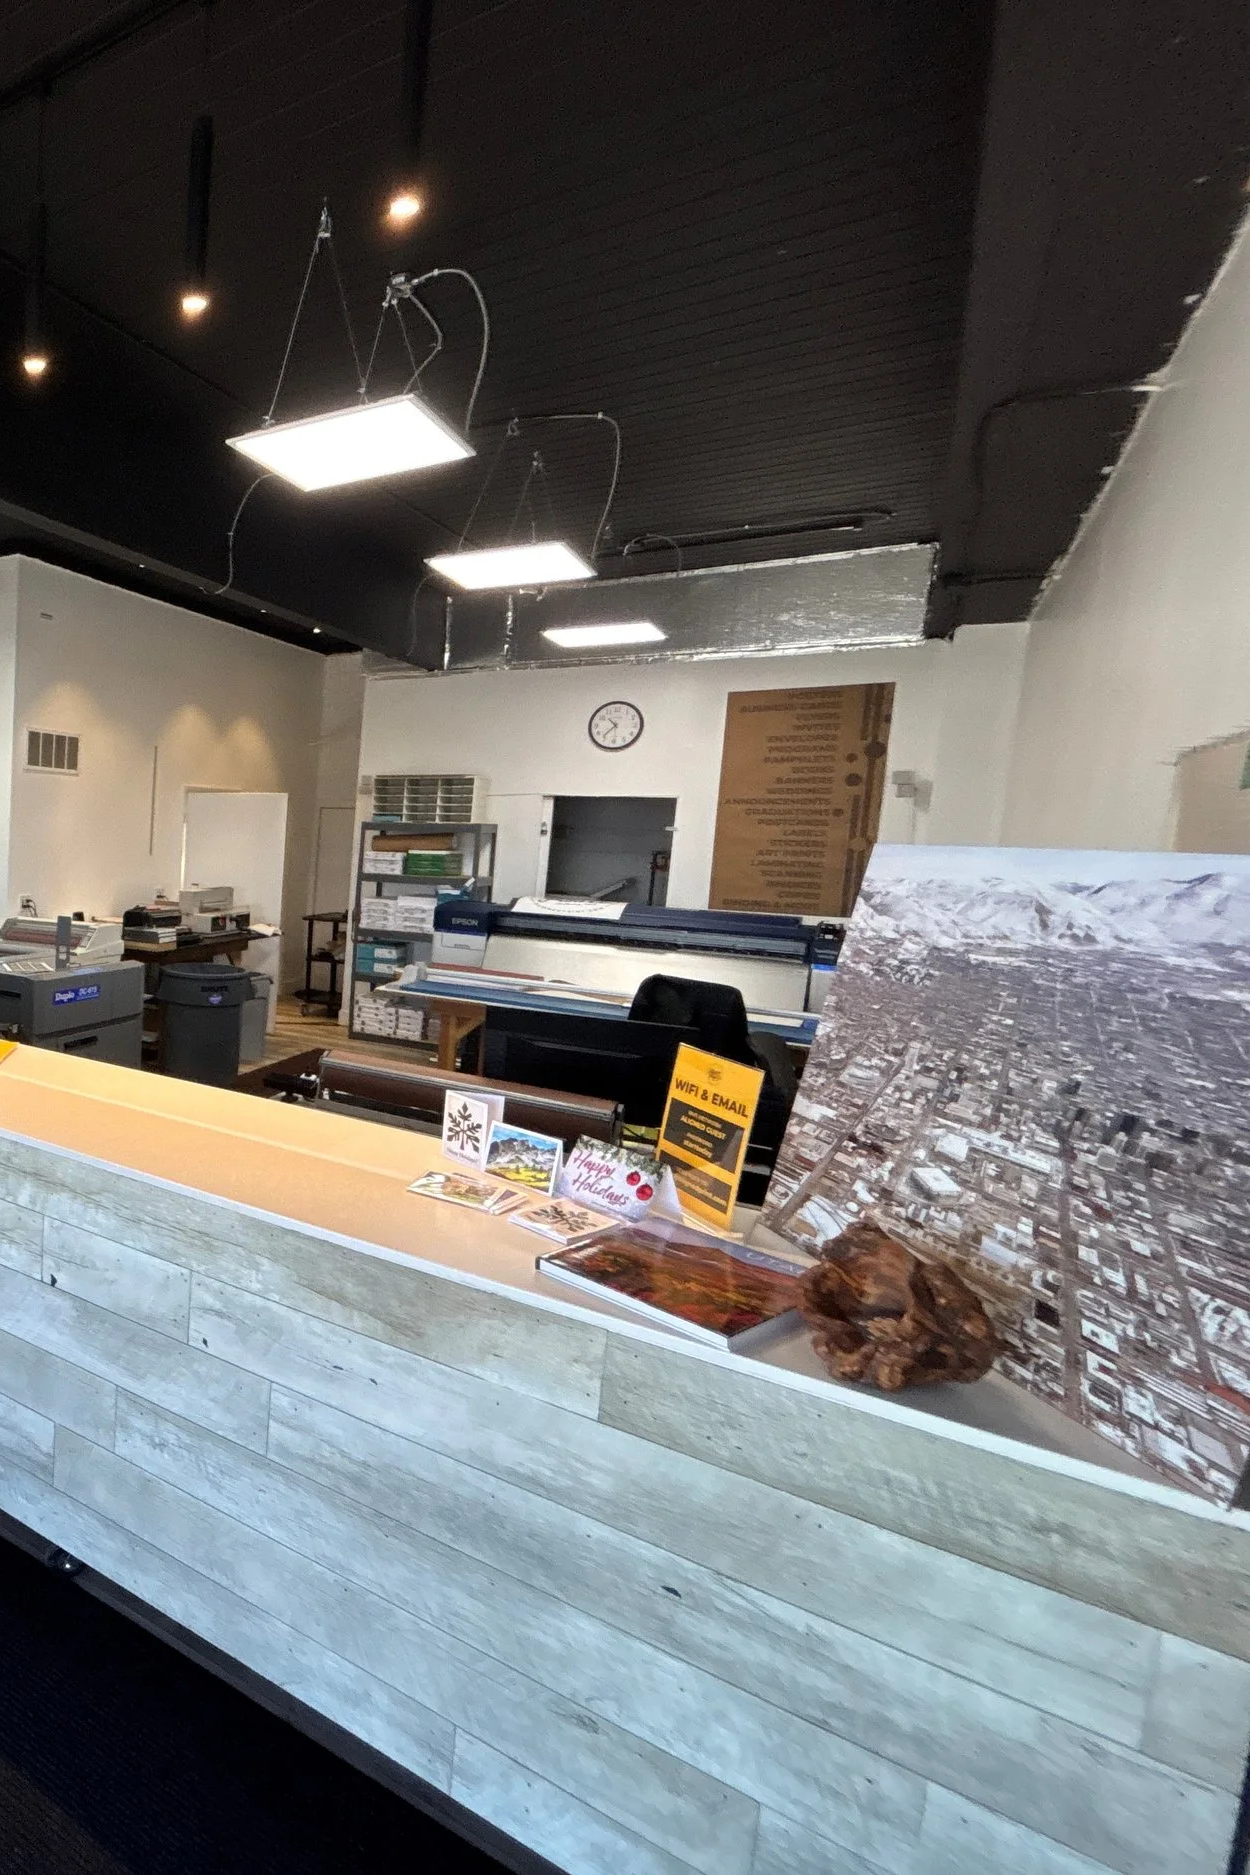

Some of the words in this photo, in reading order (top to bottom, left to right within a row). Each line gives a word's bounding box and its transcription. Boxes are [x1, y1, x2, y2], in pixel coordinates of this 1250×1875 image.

[451, 917, 479, 926] EPSON
[54, 990, 76, 1002] Duplo
[675, 1078, 699, 1098] WIFI
[700, 1088, 709, 1101] &
[711, 1093, 749, 1119] EMAIL
[573, 1150, 616, 1178] Happy
[572, 1172, 630, 1207] Holidays
